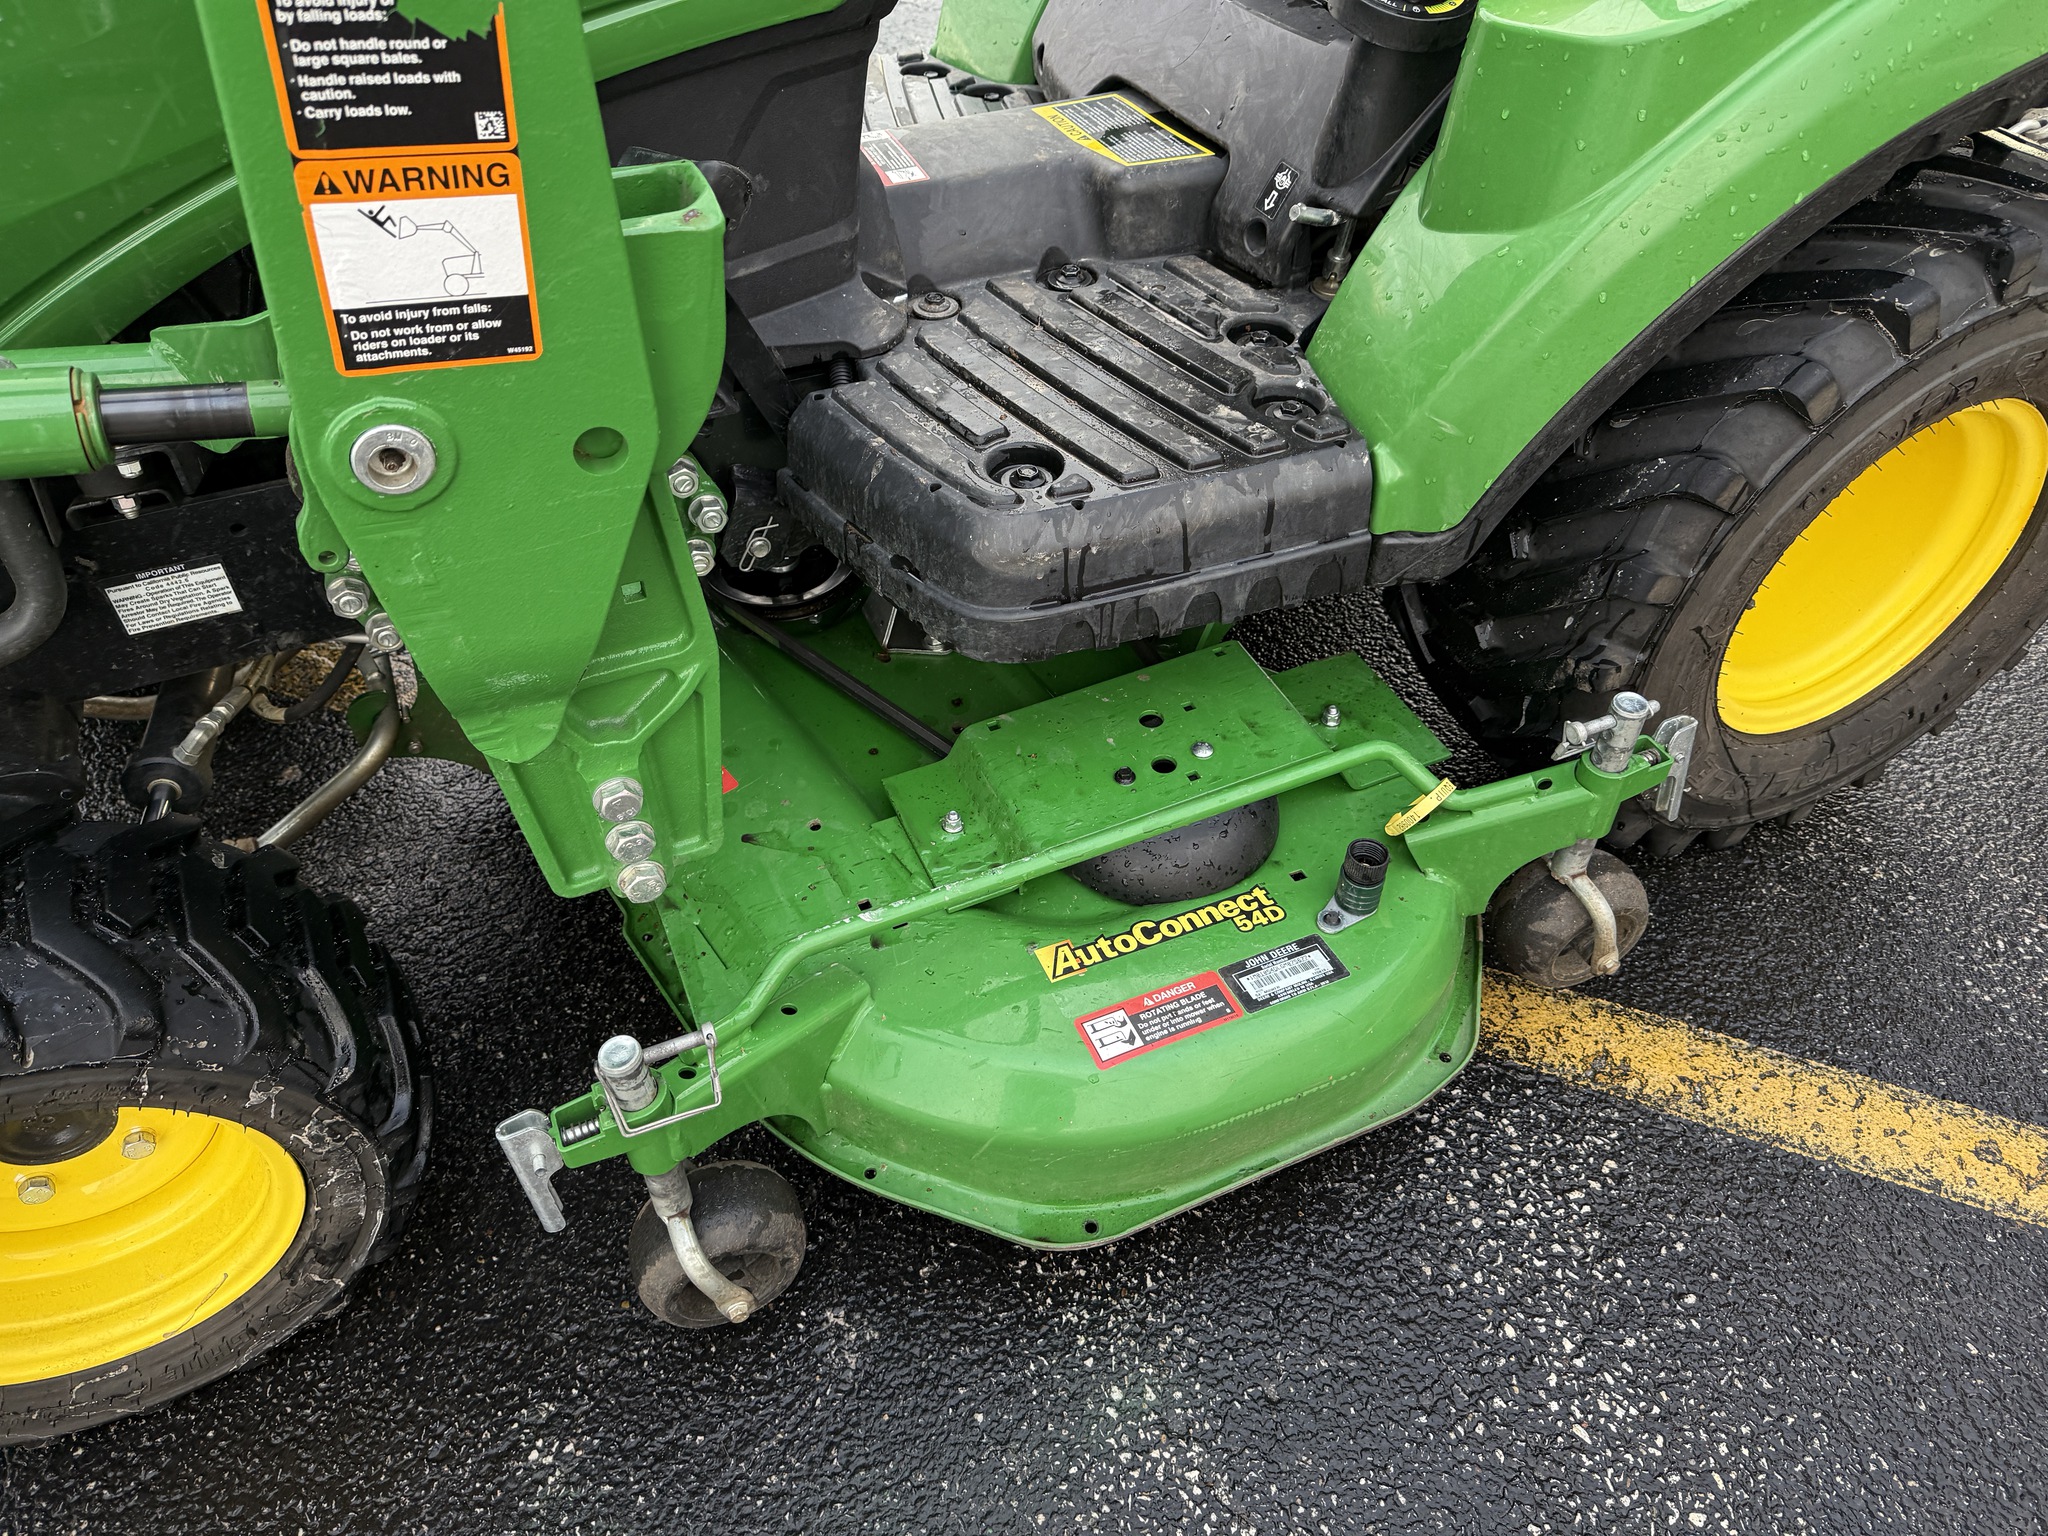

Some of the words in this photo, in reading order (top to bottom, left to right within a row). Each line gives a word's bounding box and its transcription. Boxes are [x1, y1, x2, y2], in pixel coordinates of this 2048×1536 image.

[275, 8, 294, 26] by
[296, 8, 342, 25] falling
[343, 7, 388, 22] loads:
[290, 38, 311, 52] Do
[313, 38, 337, 51] not
[340, 38, 387, 50] handle
[389, 37, 430, 50] round
[432, 38, 448, 49] or
[292, 54, 329, 70] large
[331, 53, 380, 68] square
[381, 51, 423, 65] bales.
[297, 74, 347, 87] Handle
[349, 73, 391, 86] raised
[393, 72, 431, 85] loads
[433, 71, 461, 84] with
[301, 89, 356, 101] caution.
[304, 105, 342, 120] Carry
[345, 104, 383, 118] loads
[385, 103, 412, 116] low.
[343, 162, 510, 194] WARNING
[340, 314, 356, 325] To
[359, 311, 393, 323] avoid
[395, 309, 430, 322] injury
[432, 306, 461, 318] from
[463, 303, 492, 315] falls:
[350, 330, 370, 341] Do
[371, 329, 391, 340] not
[393, 325, 424, 337] work
[426, 323, 454, 334] from
[456, 322, 469, 332] or
[471, 319, 502, 331] allow
[353, 339, 389, 352] riders
[391, 338, 407, 348] on
[409, 335, 446, 347] loader
[449, 333, 463, 343] or
[465, 332, 479, 342] its
[356, 348, 432, 363] attachments.
[106, 584, 134, 594] Pursuant
[141, 576, 170, 586] California
[170, 572, 189, 580] Public
[189, 565, 221, 575] Resources
[135, 564, 185, 580] IMPORTANT
[144, 583, 164, 591] Code
[145, 586, 174, 596] Operation
[194, 575, 225, 585] Equipment
[119, 609, 145, 618] Arrestor
[206, 590, 232, 599] Operator
[128, 597, 150, 605] Create
[150, 592, 172, 600] Sparks
[134, 601, 158, 609] Around
[211, 585, 230, 593] Spark
[122, 614, 145, 622] Should
[145, 609, 170, 617] Contact
[202, 596, 231, 605] Agencies
[162, 608, 199, 619] Regulations
[200, 602, 225, 611] Relating
[140, 618, 174, 629] Prevention
[1234, 905, 1286, 931] 54D
[1245, 954, 1269, 968] JOHN
[1269, 942, 1300, 959] DEERE
[1152, 981, 1196, 1003] DANGER
[1137, 1020, 1148, 1030] Do
[1148, 1017, 1160, 1026] not
[1201, 997, 1216, 1006] feet
[1139, 1001, 1180, 1020] ROTATING
[1180, 991, 1207, 1006] BLADE
[1141, 1025, 1162, 1036] under
[1170, 1016, 1185, 1026] into
[1185, 1009, 1206, 1020] mower
[1207, 1001, 1225, 1012] when
[1145, 1029, 1169, 1042] engine
